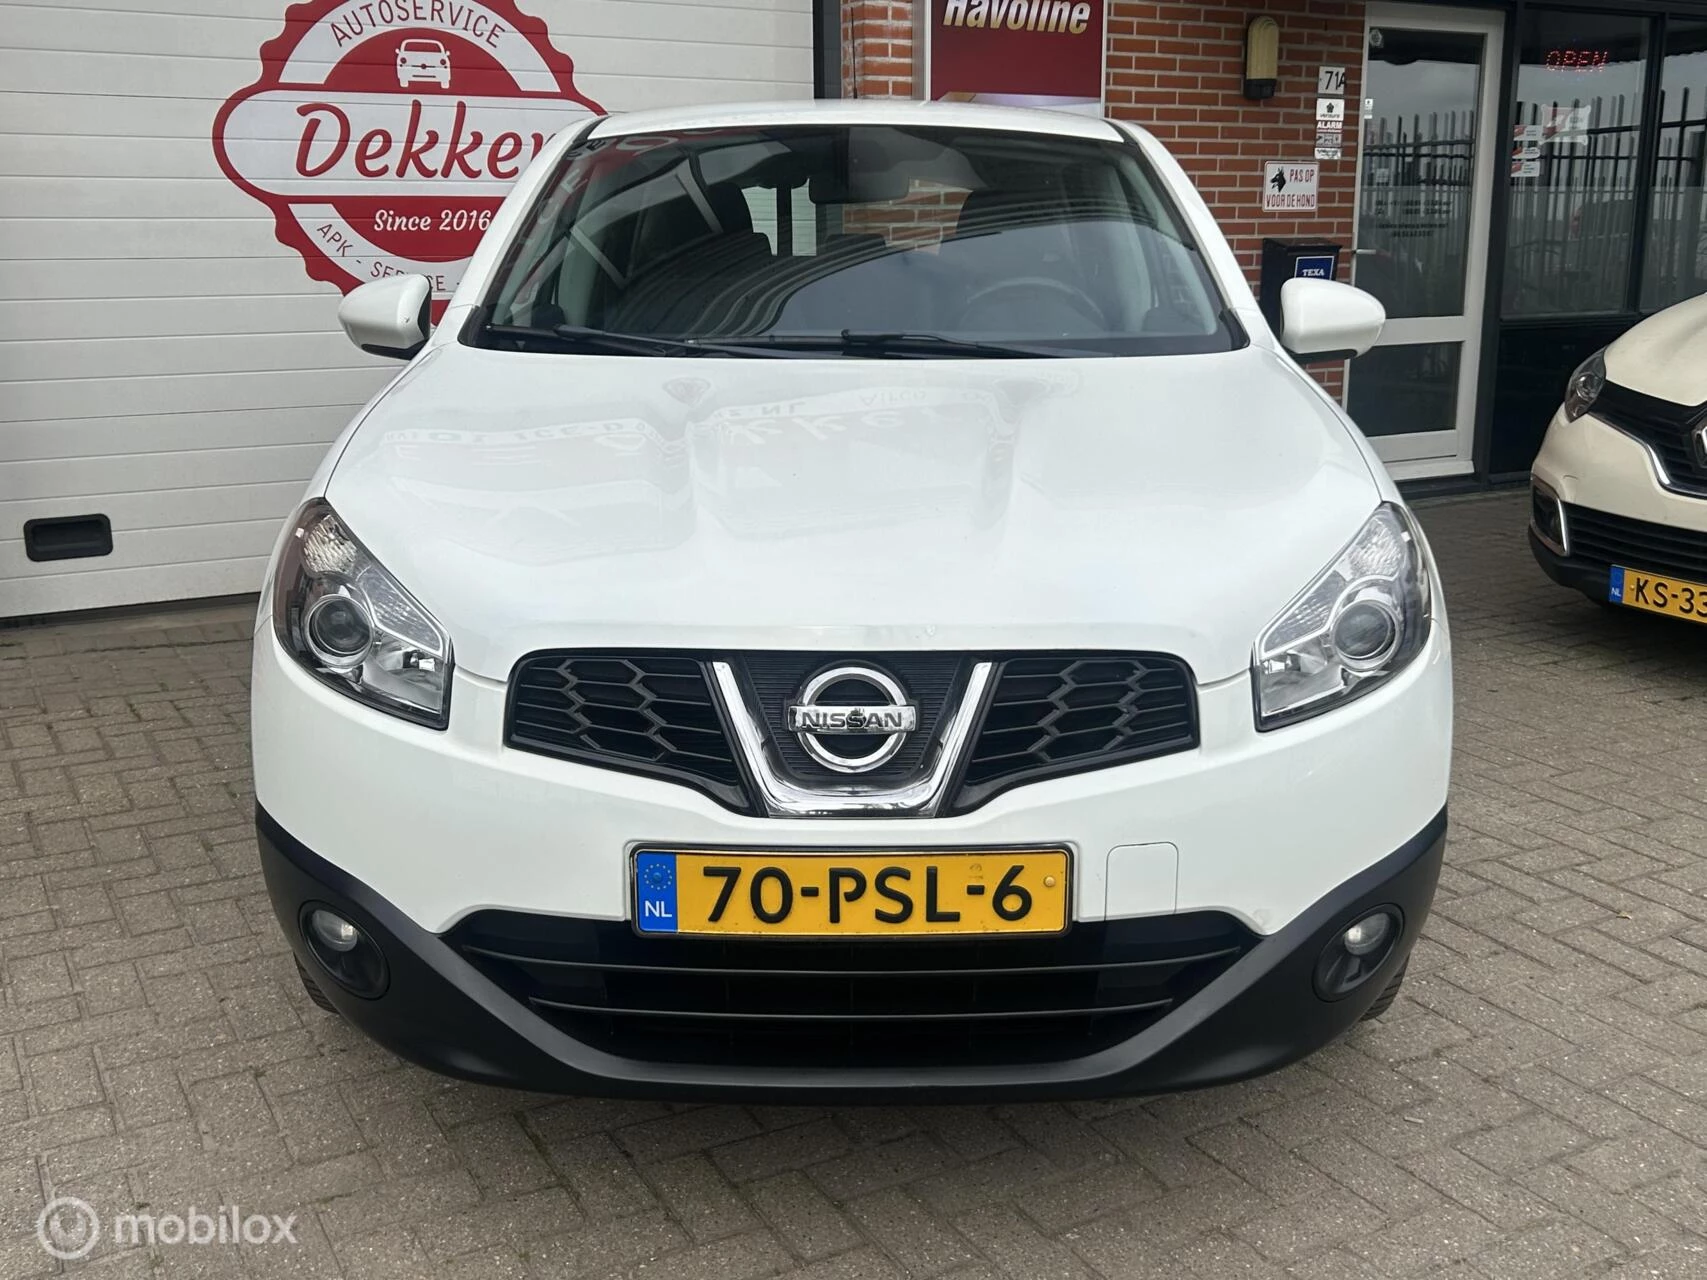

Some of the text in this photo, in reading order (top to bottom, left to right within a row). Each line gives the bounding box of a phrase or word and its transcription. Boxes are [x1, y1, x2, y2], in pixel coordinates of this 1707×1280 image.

[330, 0, 506, 48] AUTOSERVICE
[1545, 50, 1608, 73] OPEN
[1324, 70, 1348, 91] 71A
[1316, 121, 1343, 129] ALARM
[1289, 169, 1315, 183] PAS OP
[1266, 193, 1316, 208] VOOR DE HOND
[374, 207, 492, 231] Since 2016
[316, 223, 353, 257] APK
[1610, 586, 1622, 597] NL
[801, 711, 903, 729] NISSAN
[702, 864, 1033, 924] 70-PSL-6
[644, 900, 673, 918] NL
